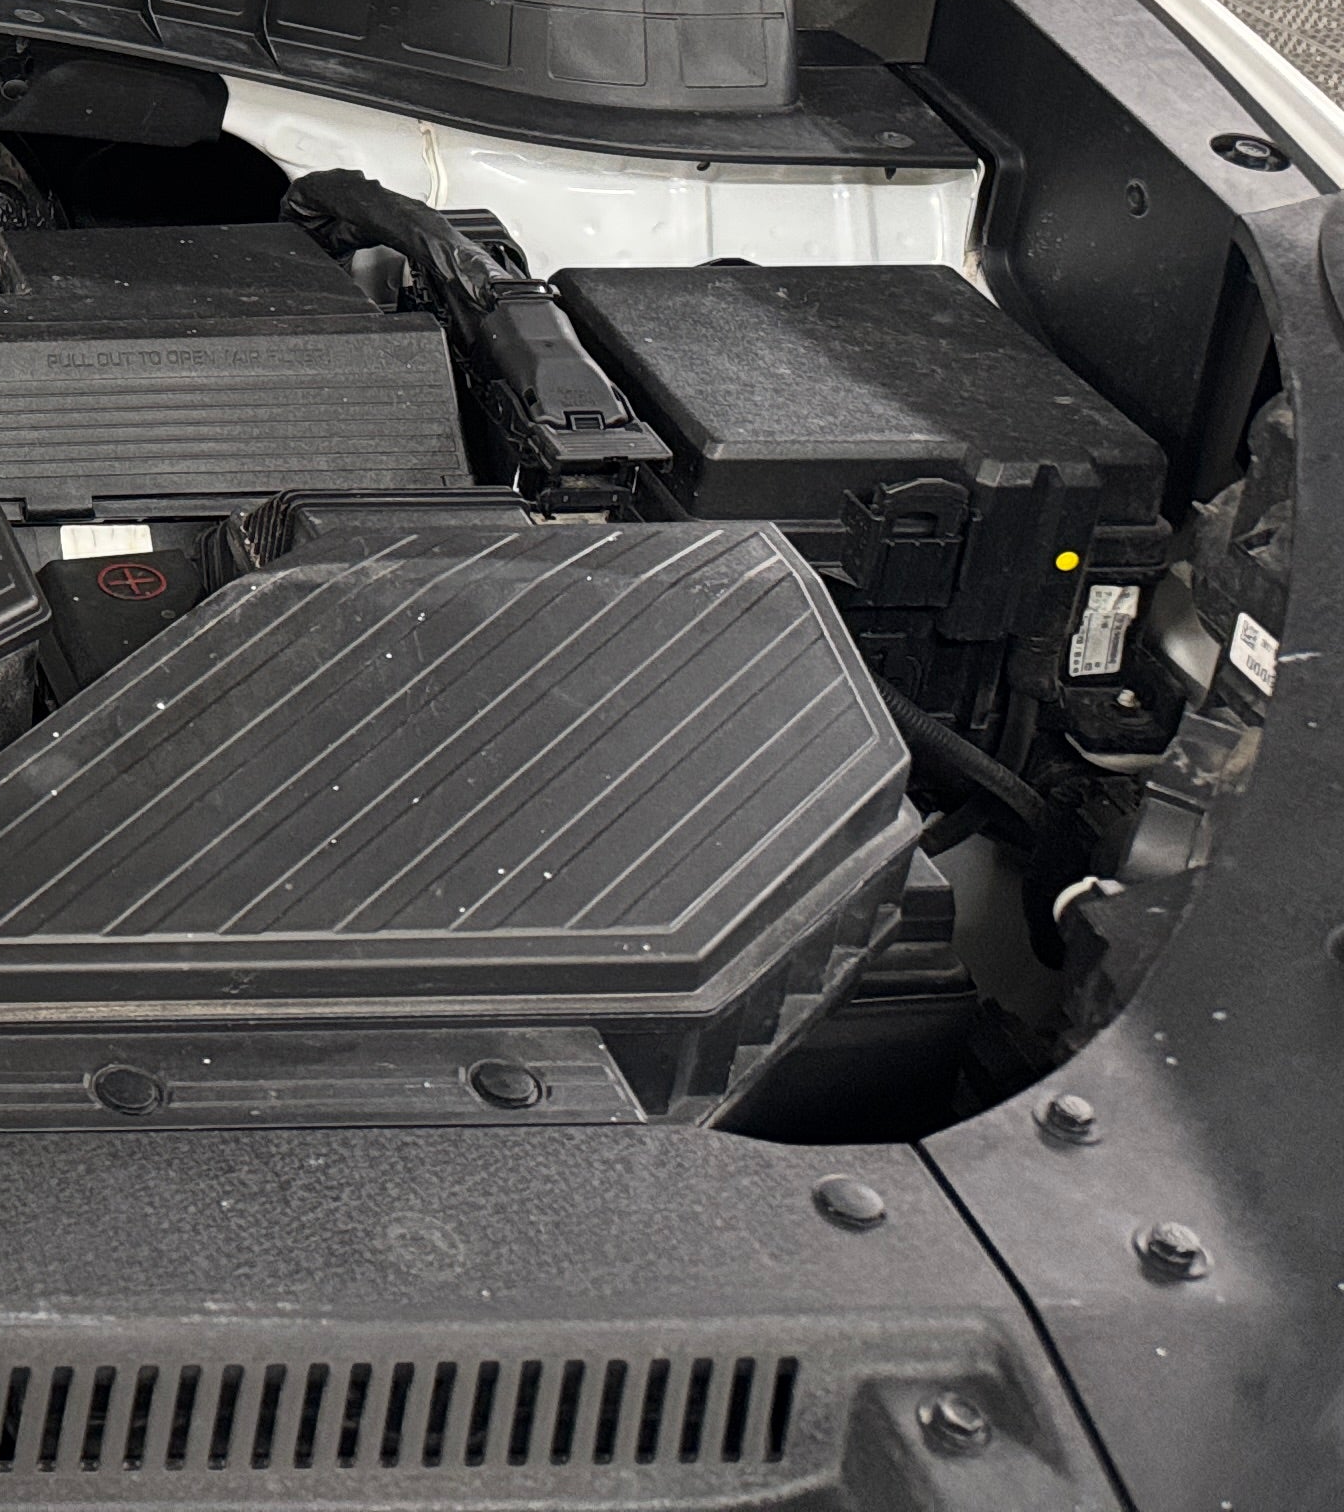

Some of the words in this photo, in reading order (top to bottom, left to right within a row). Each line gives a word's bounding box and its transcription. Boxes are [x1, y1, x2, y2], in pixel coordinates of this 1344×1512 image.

[47, 352, 94, 369] PULL
[97, 351, 134, 367] OUT
[137, 350, 162, 366] TO
[166, 348, 216, 366] OPEN
